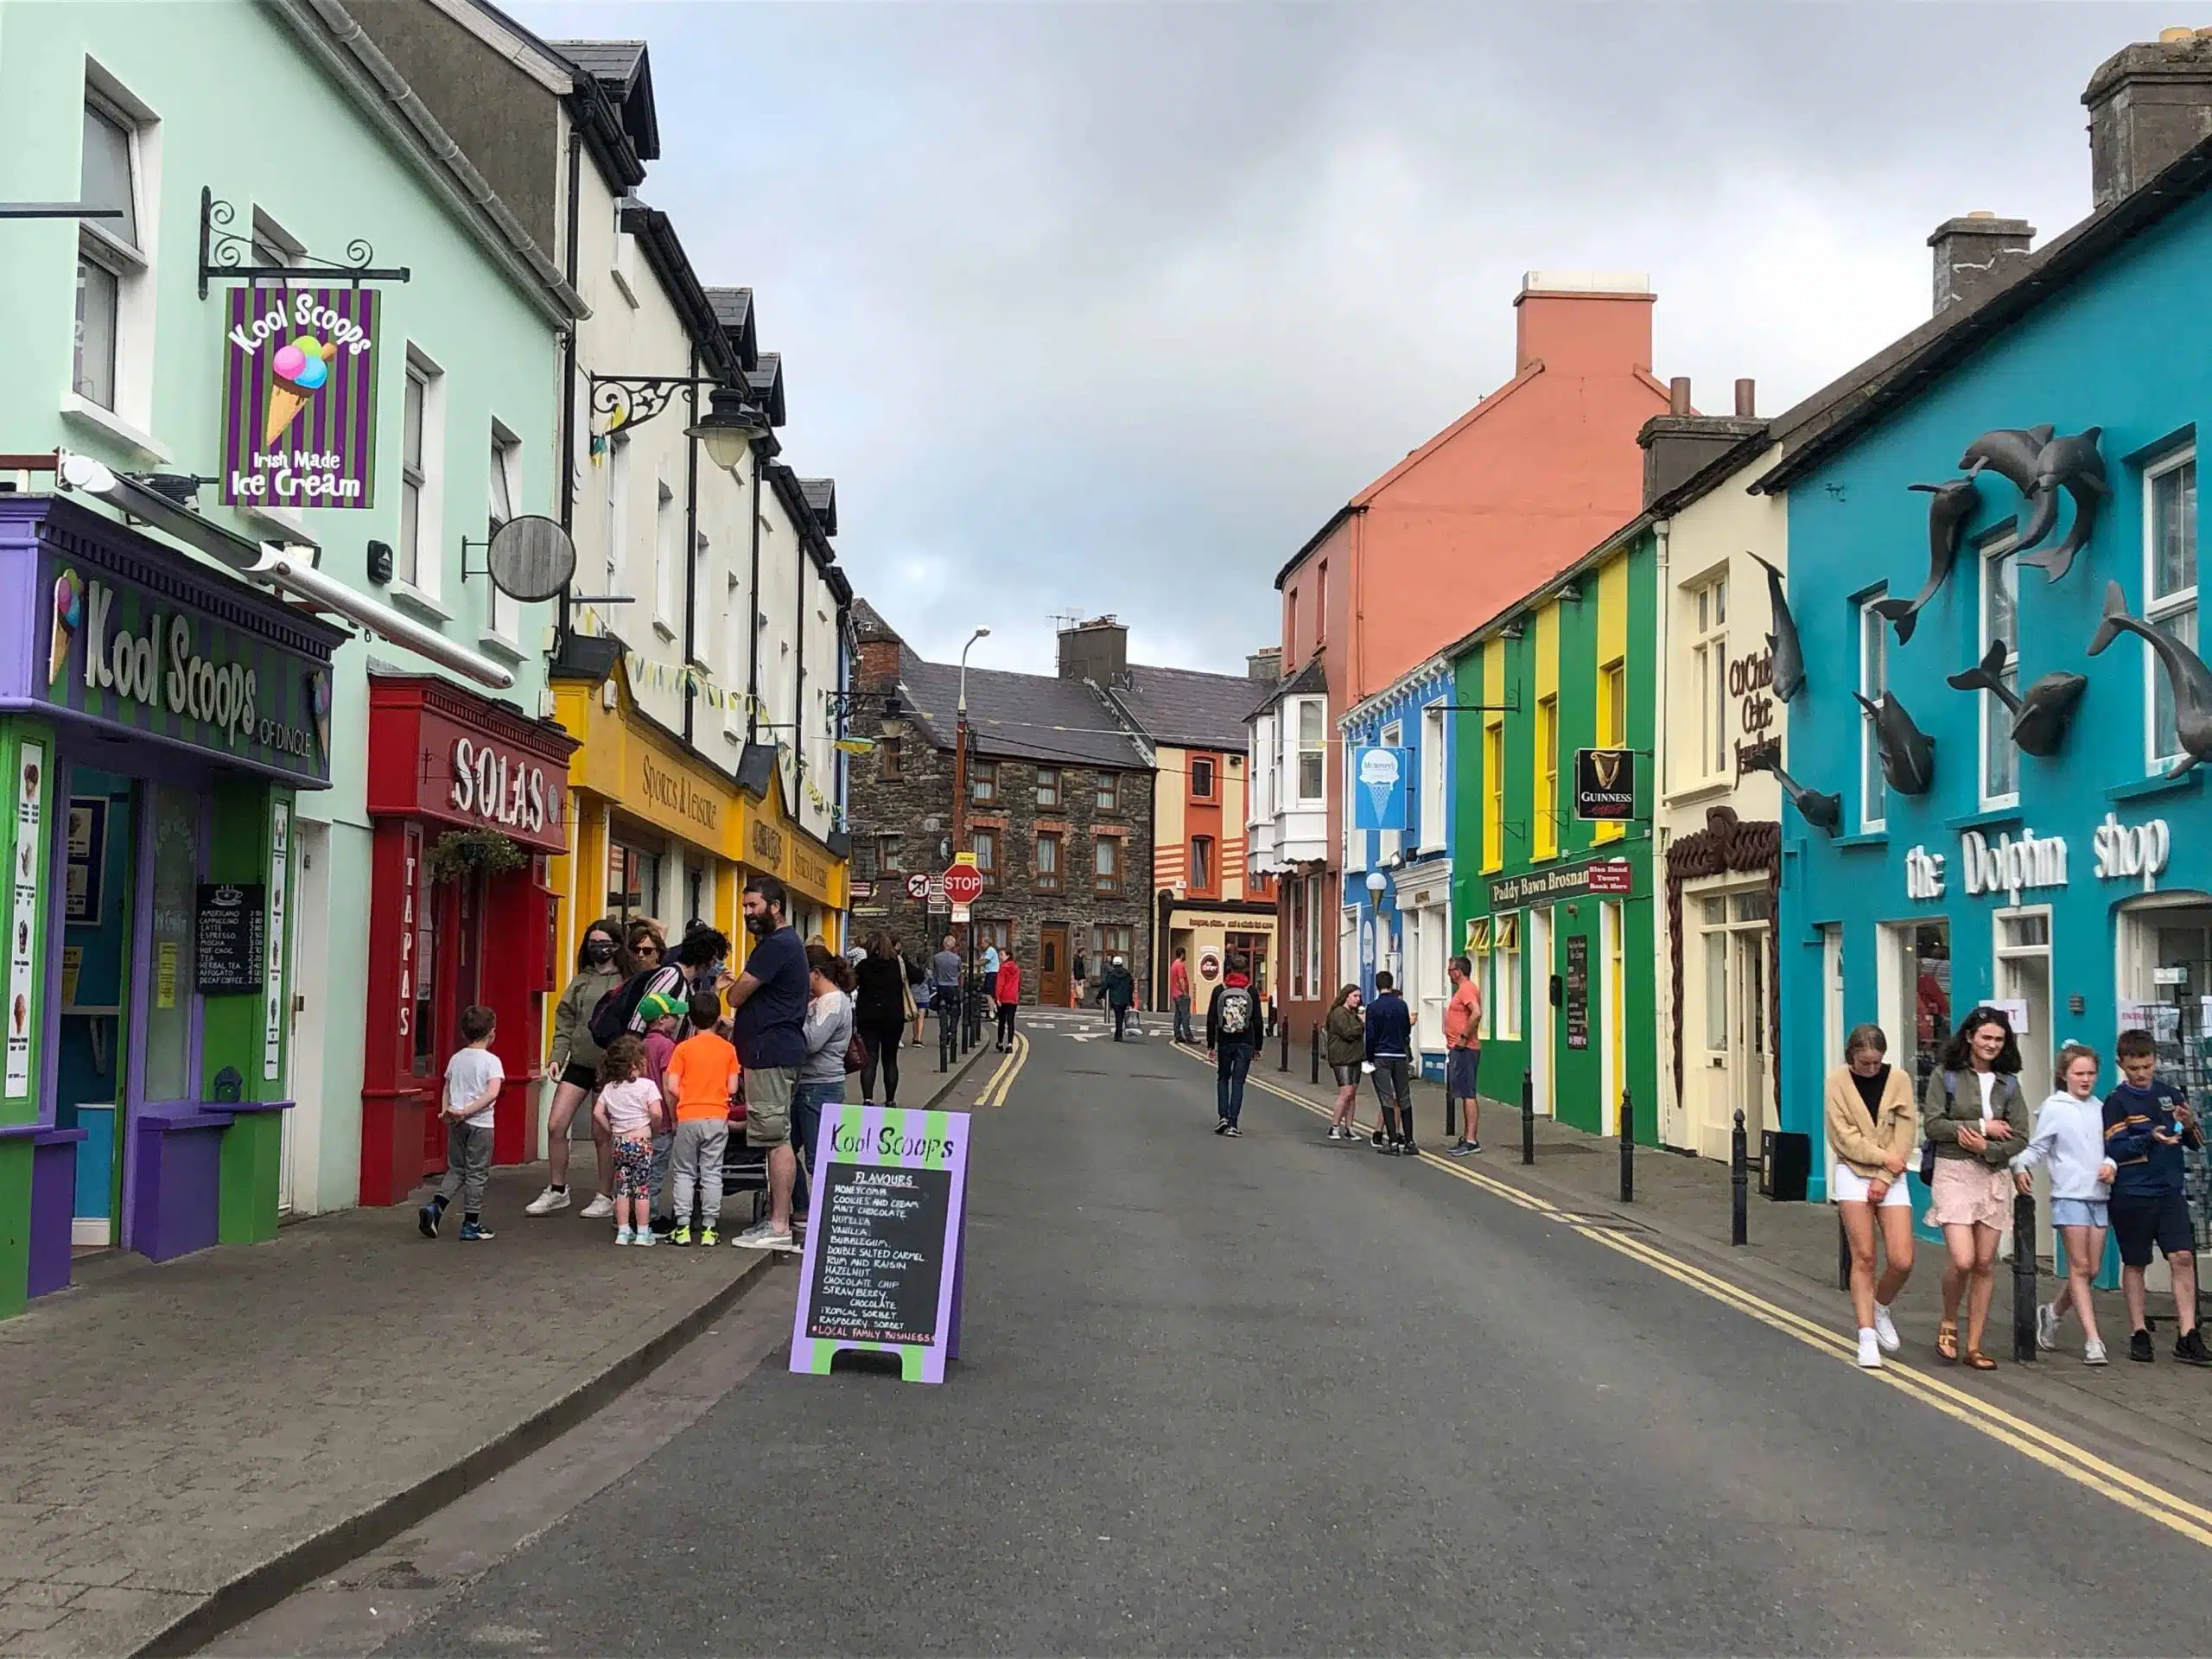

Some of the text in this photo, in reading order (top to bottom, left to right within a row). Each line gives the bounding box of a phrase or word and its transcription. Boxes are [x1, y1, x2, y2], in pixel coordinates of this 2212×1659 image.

[228, 293, 372, 356] Kool Scoops
[253, 450, 340, 470] Irish Made
[232, 468, 361, 497] Ice Cream
[85, 580, 257, 747] Kool Scoops
[260, 718, 311, 758] OF DINGLE
[452, 738, 543, 833] SOLAS
[679, 776, 685, 815] &
[1581, 791, 1632, 802] GUINNESS
[1904, 812, 2170, 906] the Dolphin shop
[944, 876, 981, 891] STOP
[1493, 870, 1589, 904] Paddy Bawn Brosnan
[400, 858, 415, 1036] TAPAS
[830, 1123, 954, 1161] Kool Scoops
[855, 1171, 913, 1186] FLAVOURS
[833, 1195, 871, 1205] COOKIES
[890, 1199, 919, 1209] CREAM
[832, 1205, 906, 1218] MINT CHOCOLATE
[831, 1214, 871, 1225] NUTELLA
[827, 1244, 856, 1255] DOUBLE
[859, 1247, 890, 1258] SALTED
[826, 1255, 906, 1269] RUM AND RAISIN
[823, 1276, 872, 1287] CHOCOLATE
[849, 1298, 897, 1309] CHOCOLATE
[820, 1306, 898, 1319] TROPICAL SORBET
[874, 1320, 905, 1330] SORBET
[852, 1329, 880, 1339] FAMILY
